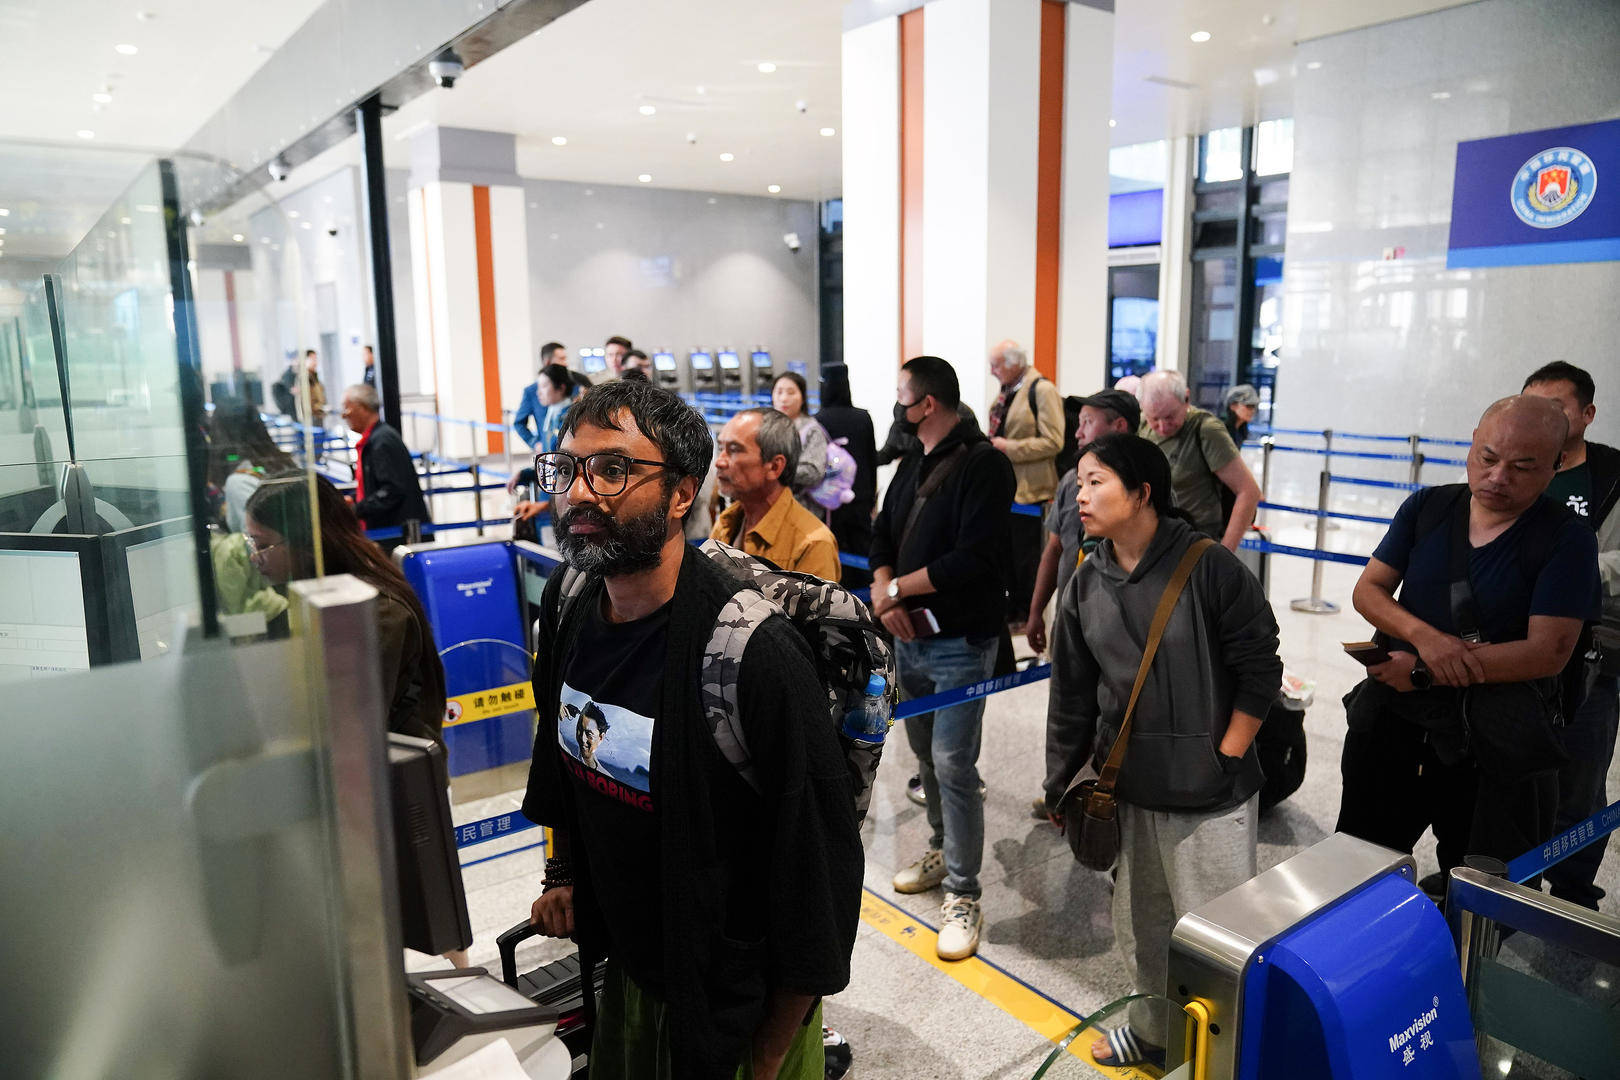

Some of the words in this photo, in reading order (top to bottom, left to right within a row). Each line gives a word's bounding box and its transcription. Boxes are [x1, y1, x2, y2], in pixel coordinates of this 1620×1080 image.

[1543, 820, 1595, 862] 中国移民管理
[1402, 1030, 1434, 1067] 盛视
